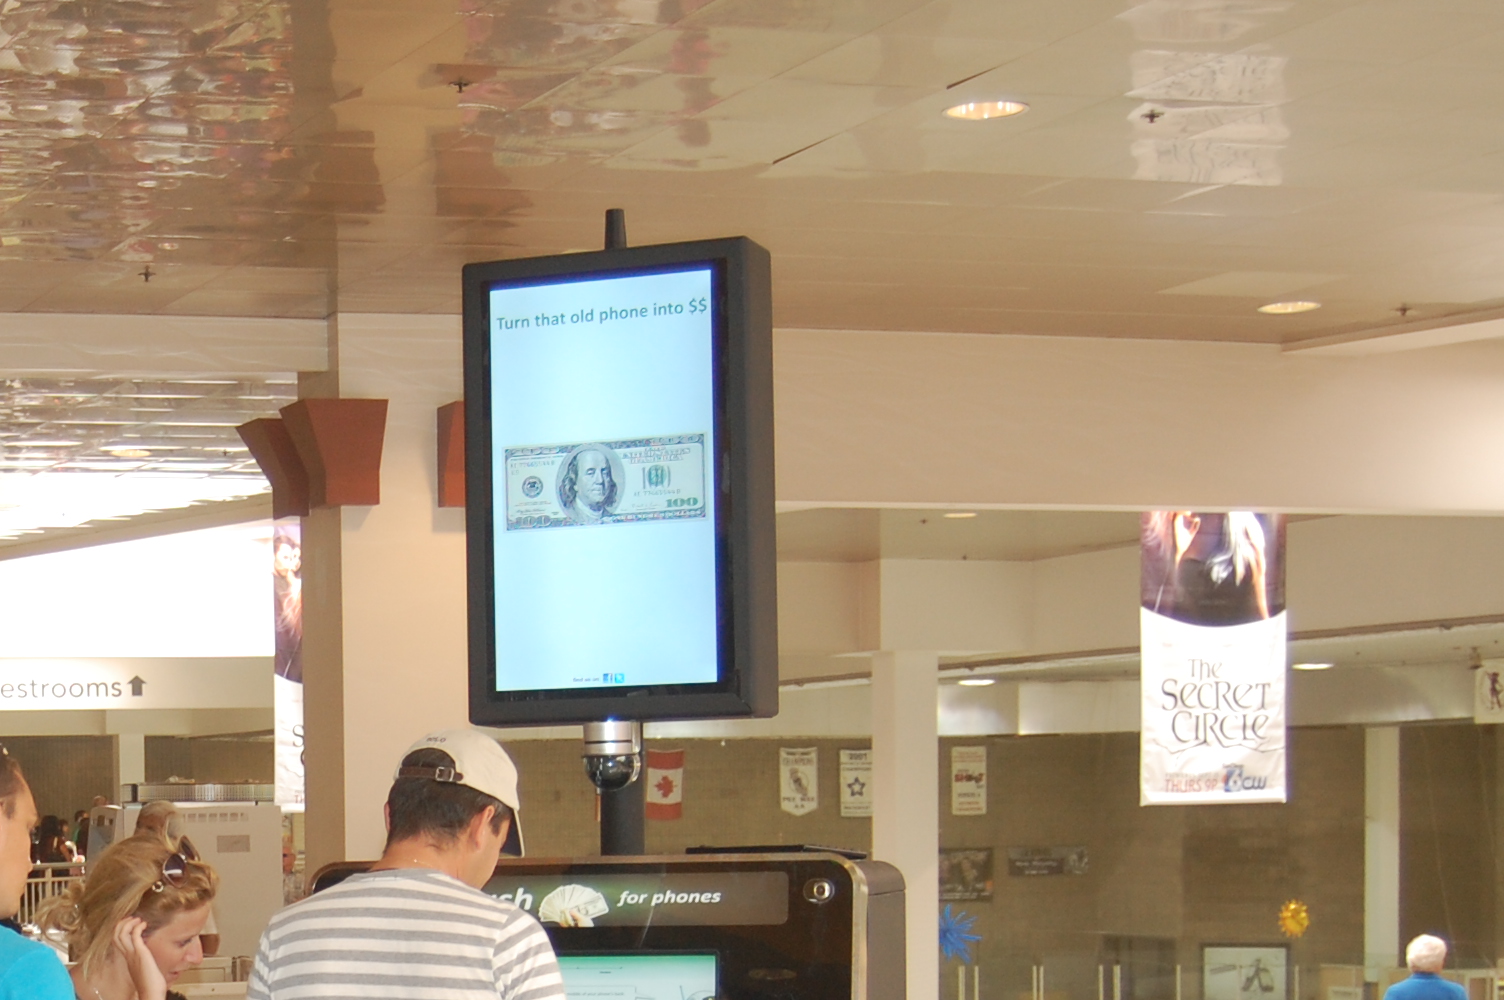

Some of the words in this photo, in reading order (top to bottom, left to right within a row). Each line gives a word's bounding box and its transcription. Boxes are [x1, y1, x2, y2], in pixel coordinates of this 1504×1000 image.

[497, 316, 530, 331] Turn
[535, 311, 566, 327] that
[570, 308, 594, 324] old
[599, 304, 649, 323] phone
[653, 300, 684, 316] into
[688, 297, 707, 315] $$
[665, 497, 699, 508] 100
[1187, 658, 1223, 679] The
[1165, 778, 1202, 793] THURS
[1205, 778, 1218, 792] 9P
[617, 890, 647, 907] for
[651, 890, 721, 906] phones
